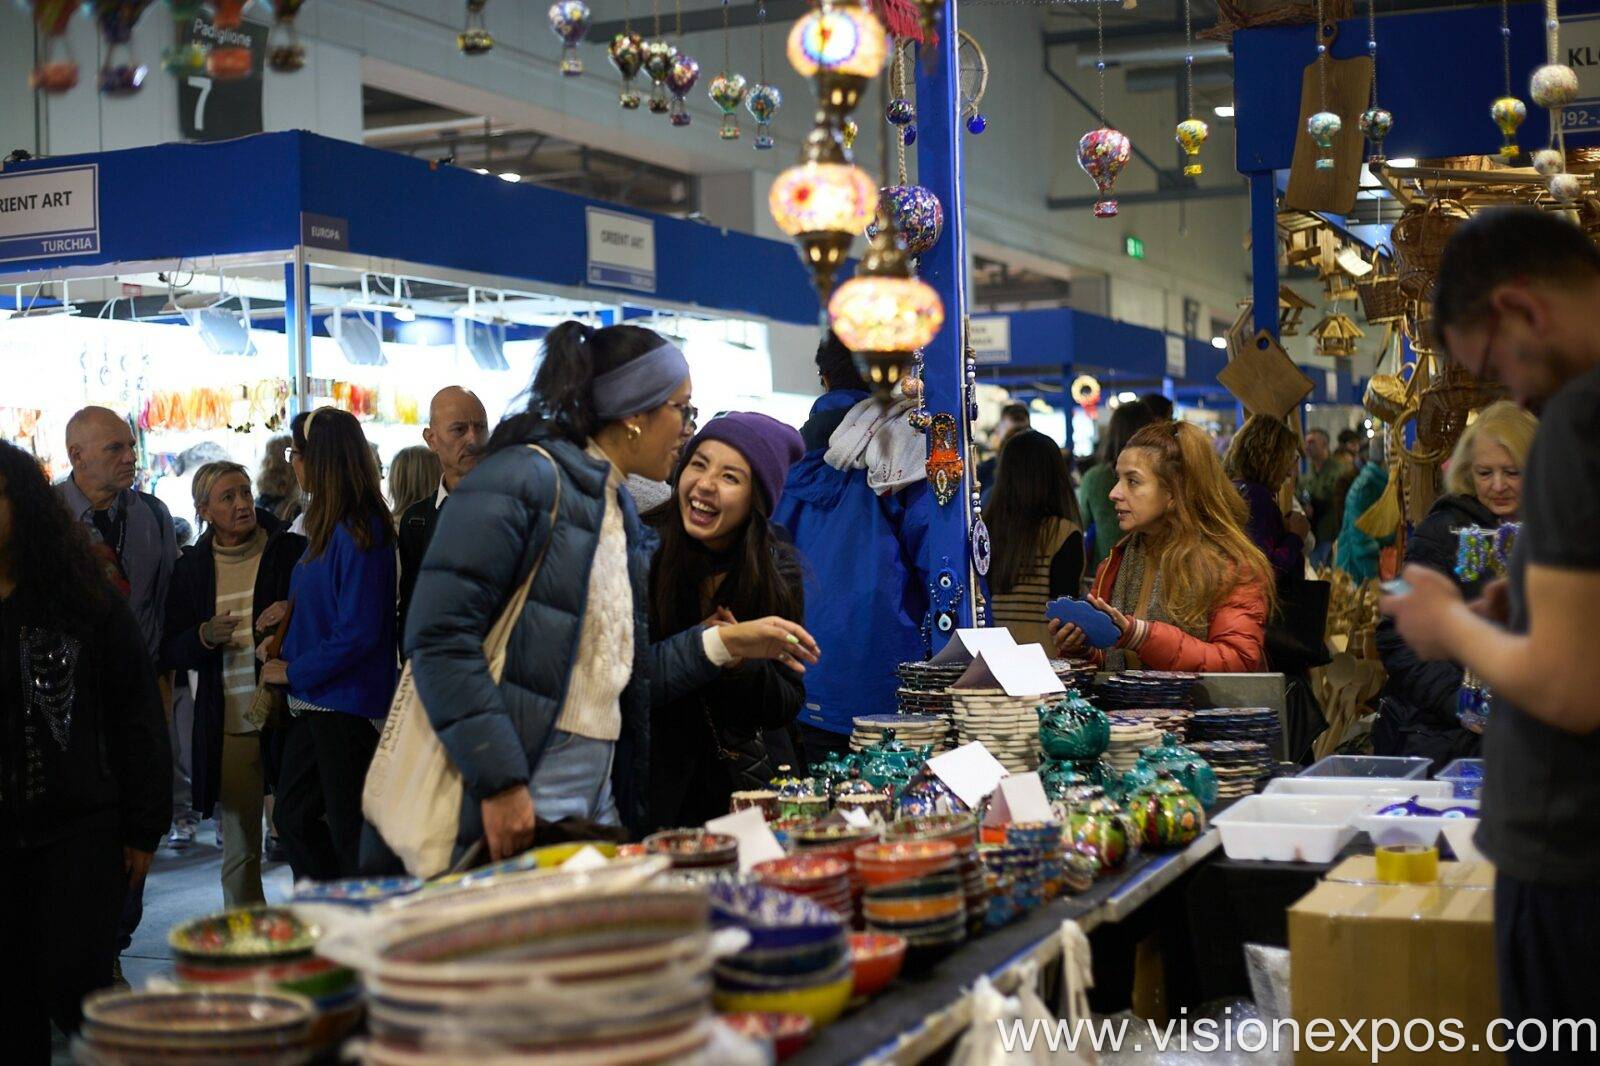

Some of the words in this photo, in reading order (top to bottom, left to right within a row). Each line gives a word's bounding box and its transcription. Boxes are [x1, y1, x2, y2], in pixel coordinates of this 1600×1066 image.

[1568, 46, 1600, 67] KL
[188, 76, 211, 131] 7
[41, 190, 72, 208] ART
[311, 225, 340, 241] EUROPA
[41, 237, 92, 252] TURCHIA
